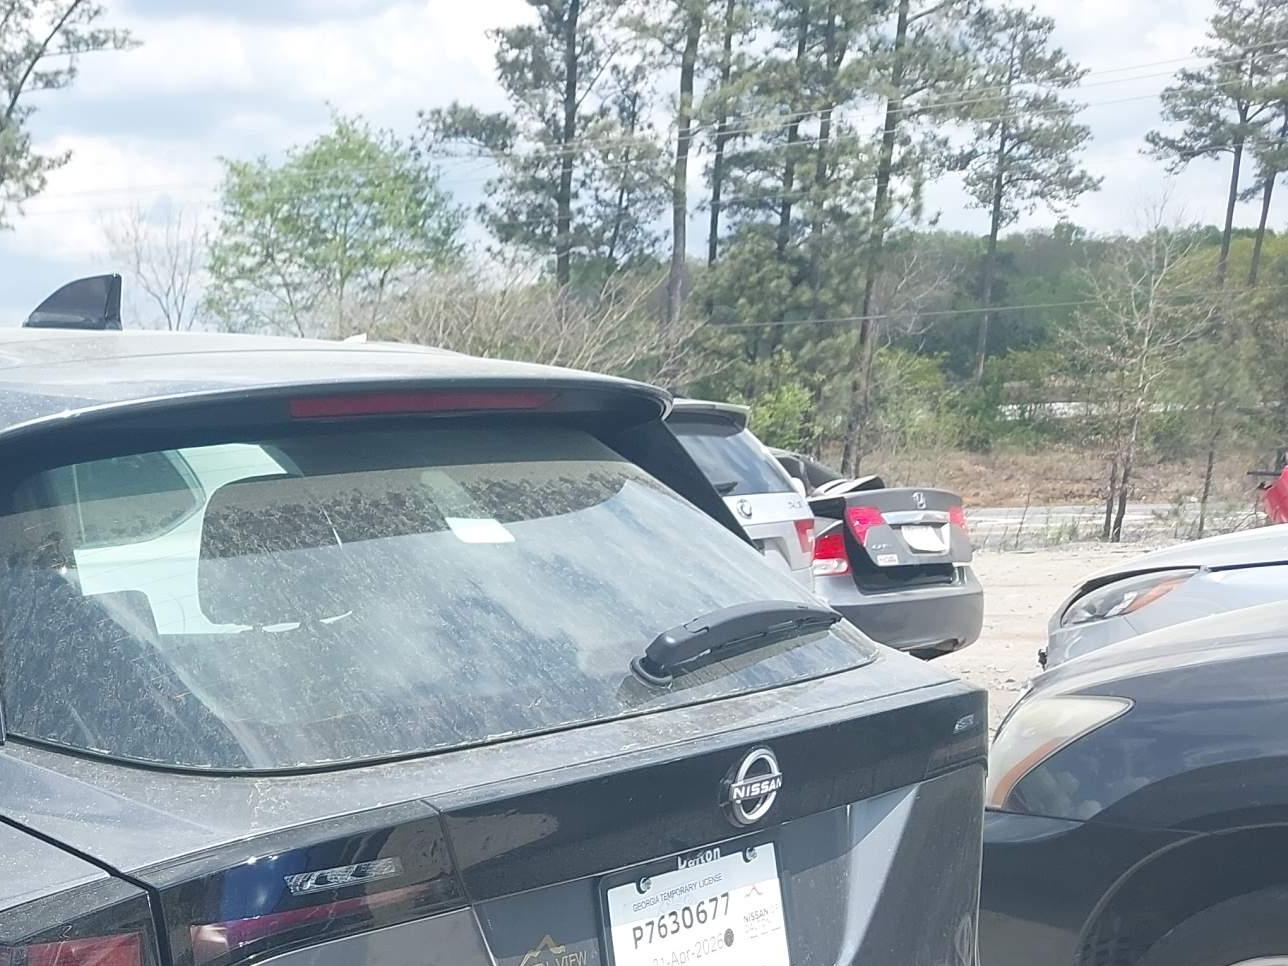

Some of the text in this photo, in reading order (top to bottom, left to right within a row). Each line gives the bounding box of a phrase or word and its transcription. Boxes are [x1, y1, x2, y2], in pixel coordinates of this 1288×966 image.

[732, 778, 782, 799] NISSAN
[632, 873, 723, 912] GEORGIA TEMPORARY LICENSE
[632, 891, 730, 950] P7630677
